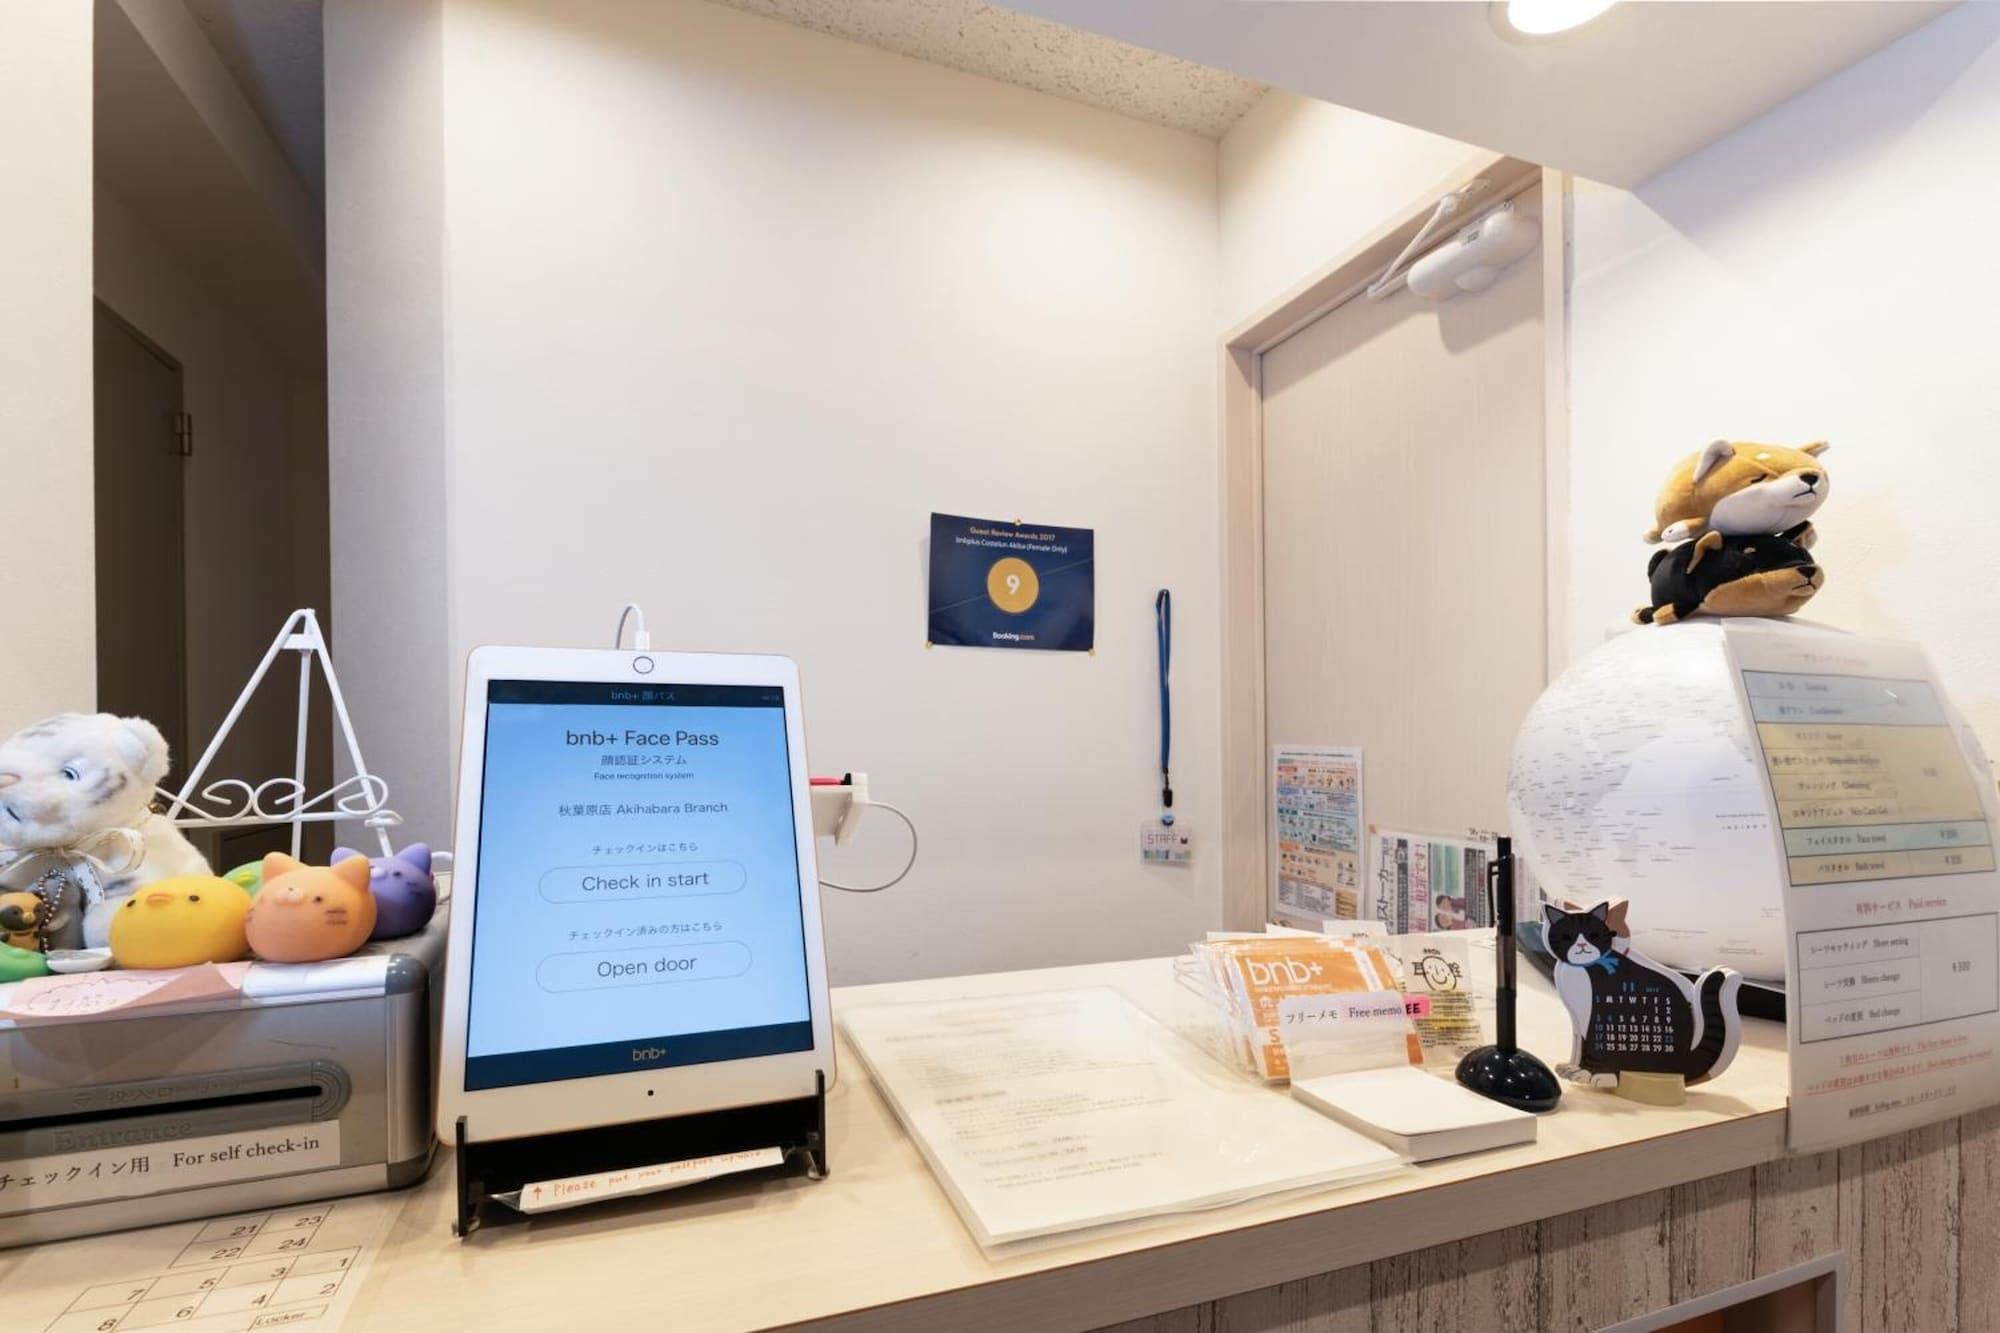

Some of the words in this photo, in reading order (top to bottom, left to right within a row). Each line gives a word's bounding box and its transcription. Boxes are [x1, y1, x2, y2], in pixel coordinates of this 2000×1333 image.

[970, 527, 988, 535] Guest
[991, 529, 1013, 538] Review
[1015, 532, 1038, 540] Awards
[1006, 574, 1020, 594] 9
[992, 632, 1035, 642] Booking.com
[566, 731, 618, 746] bnb+
[625, 731, 670, 746] Face
[676, 731, 719, 746] Pass
[600, 754, 687, 766] 顔認証システム
[594, 772, 614, 780] Face
[616, 772, 664, 782] recognition
[666, 772, 694, 781] system
[560, 804, 612, 816] 秋葉原店
[617, 803, 680, 815] Akihabara
[684, 802, 728, 814] Branch
[592, 842, 698, 855] チェックインはこちら
[582, 875, 639, 891] Check
[646, 874, 661, 888] in
[668, 872, 709, 887] start
[568, 922, 723, 941] チェックイン済みの方はこちら
[597, 960, 648, 978] Open
[654, 957, 697, 973] door
[1250, 958, 1323, 986] bnb+
[1286, 1008, 1338, 1024] フリーメモ
[1348, 1006, 1372, 1019] Free
[1373, 1006, 1402, 1017] memo
[632, 1048, 666, 1062] bnb+
[173, 1152, 205, 1168] For
[210, 1146, 242, 1164] self
[246, 1137, 320, 1158] check-in
[554, 1179, 598, 1196] Please
[295, 1216, 322, 1226] 23
[232, 1224, 256, 1236] 21
[278, 1238, 306, 1250] 24
[210, 1247, 241, 1260] 22
[340, 1257, 348, 1268] 1
[270, 1268, 286, 1278] 3
[200, 1279, 216, 1290] 5
[320, 1284, 336, 1295] 2
[128, 1288, 145, 1300] 7
[252, 1294, 267, 1306] 4
[176, 1307, 192, 1318] 6
[98, 1319, 117, 1331] 8
